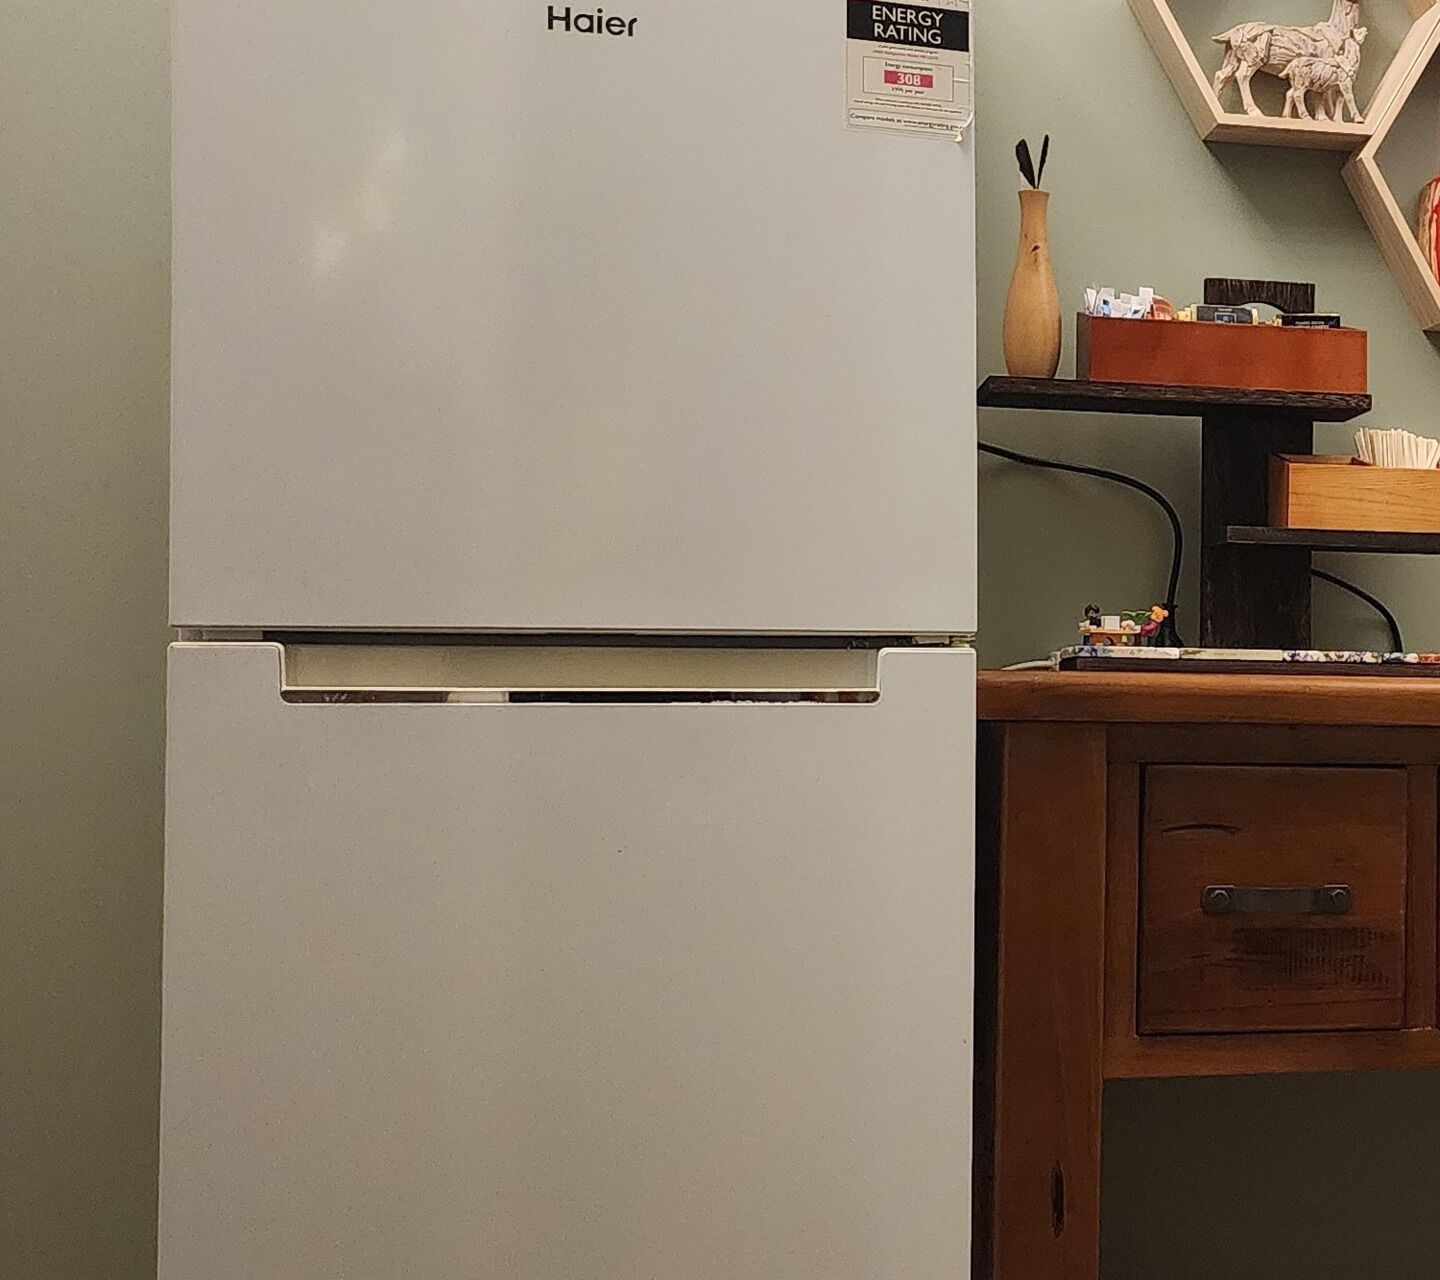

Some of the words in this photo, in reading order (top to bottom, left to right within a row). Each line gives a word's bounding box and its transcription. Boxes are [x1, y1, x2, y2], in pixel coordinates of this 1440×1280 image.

[547, 5, 638, 37] Haier
[872, 5, 943, 27] ENERGY
[874, 22, 941, 44] RATING
[897, 73, 921, 86] 308
